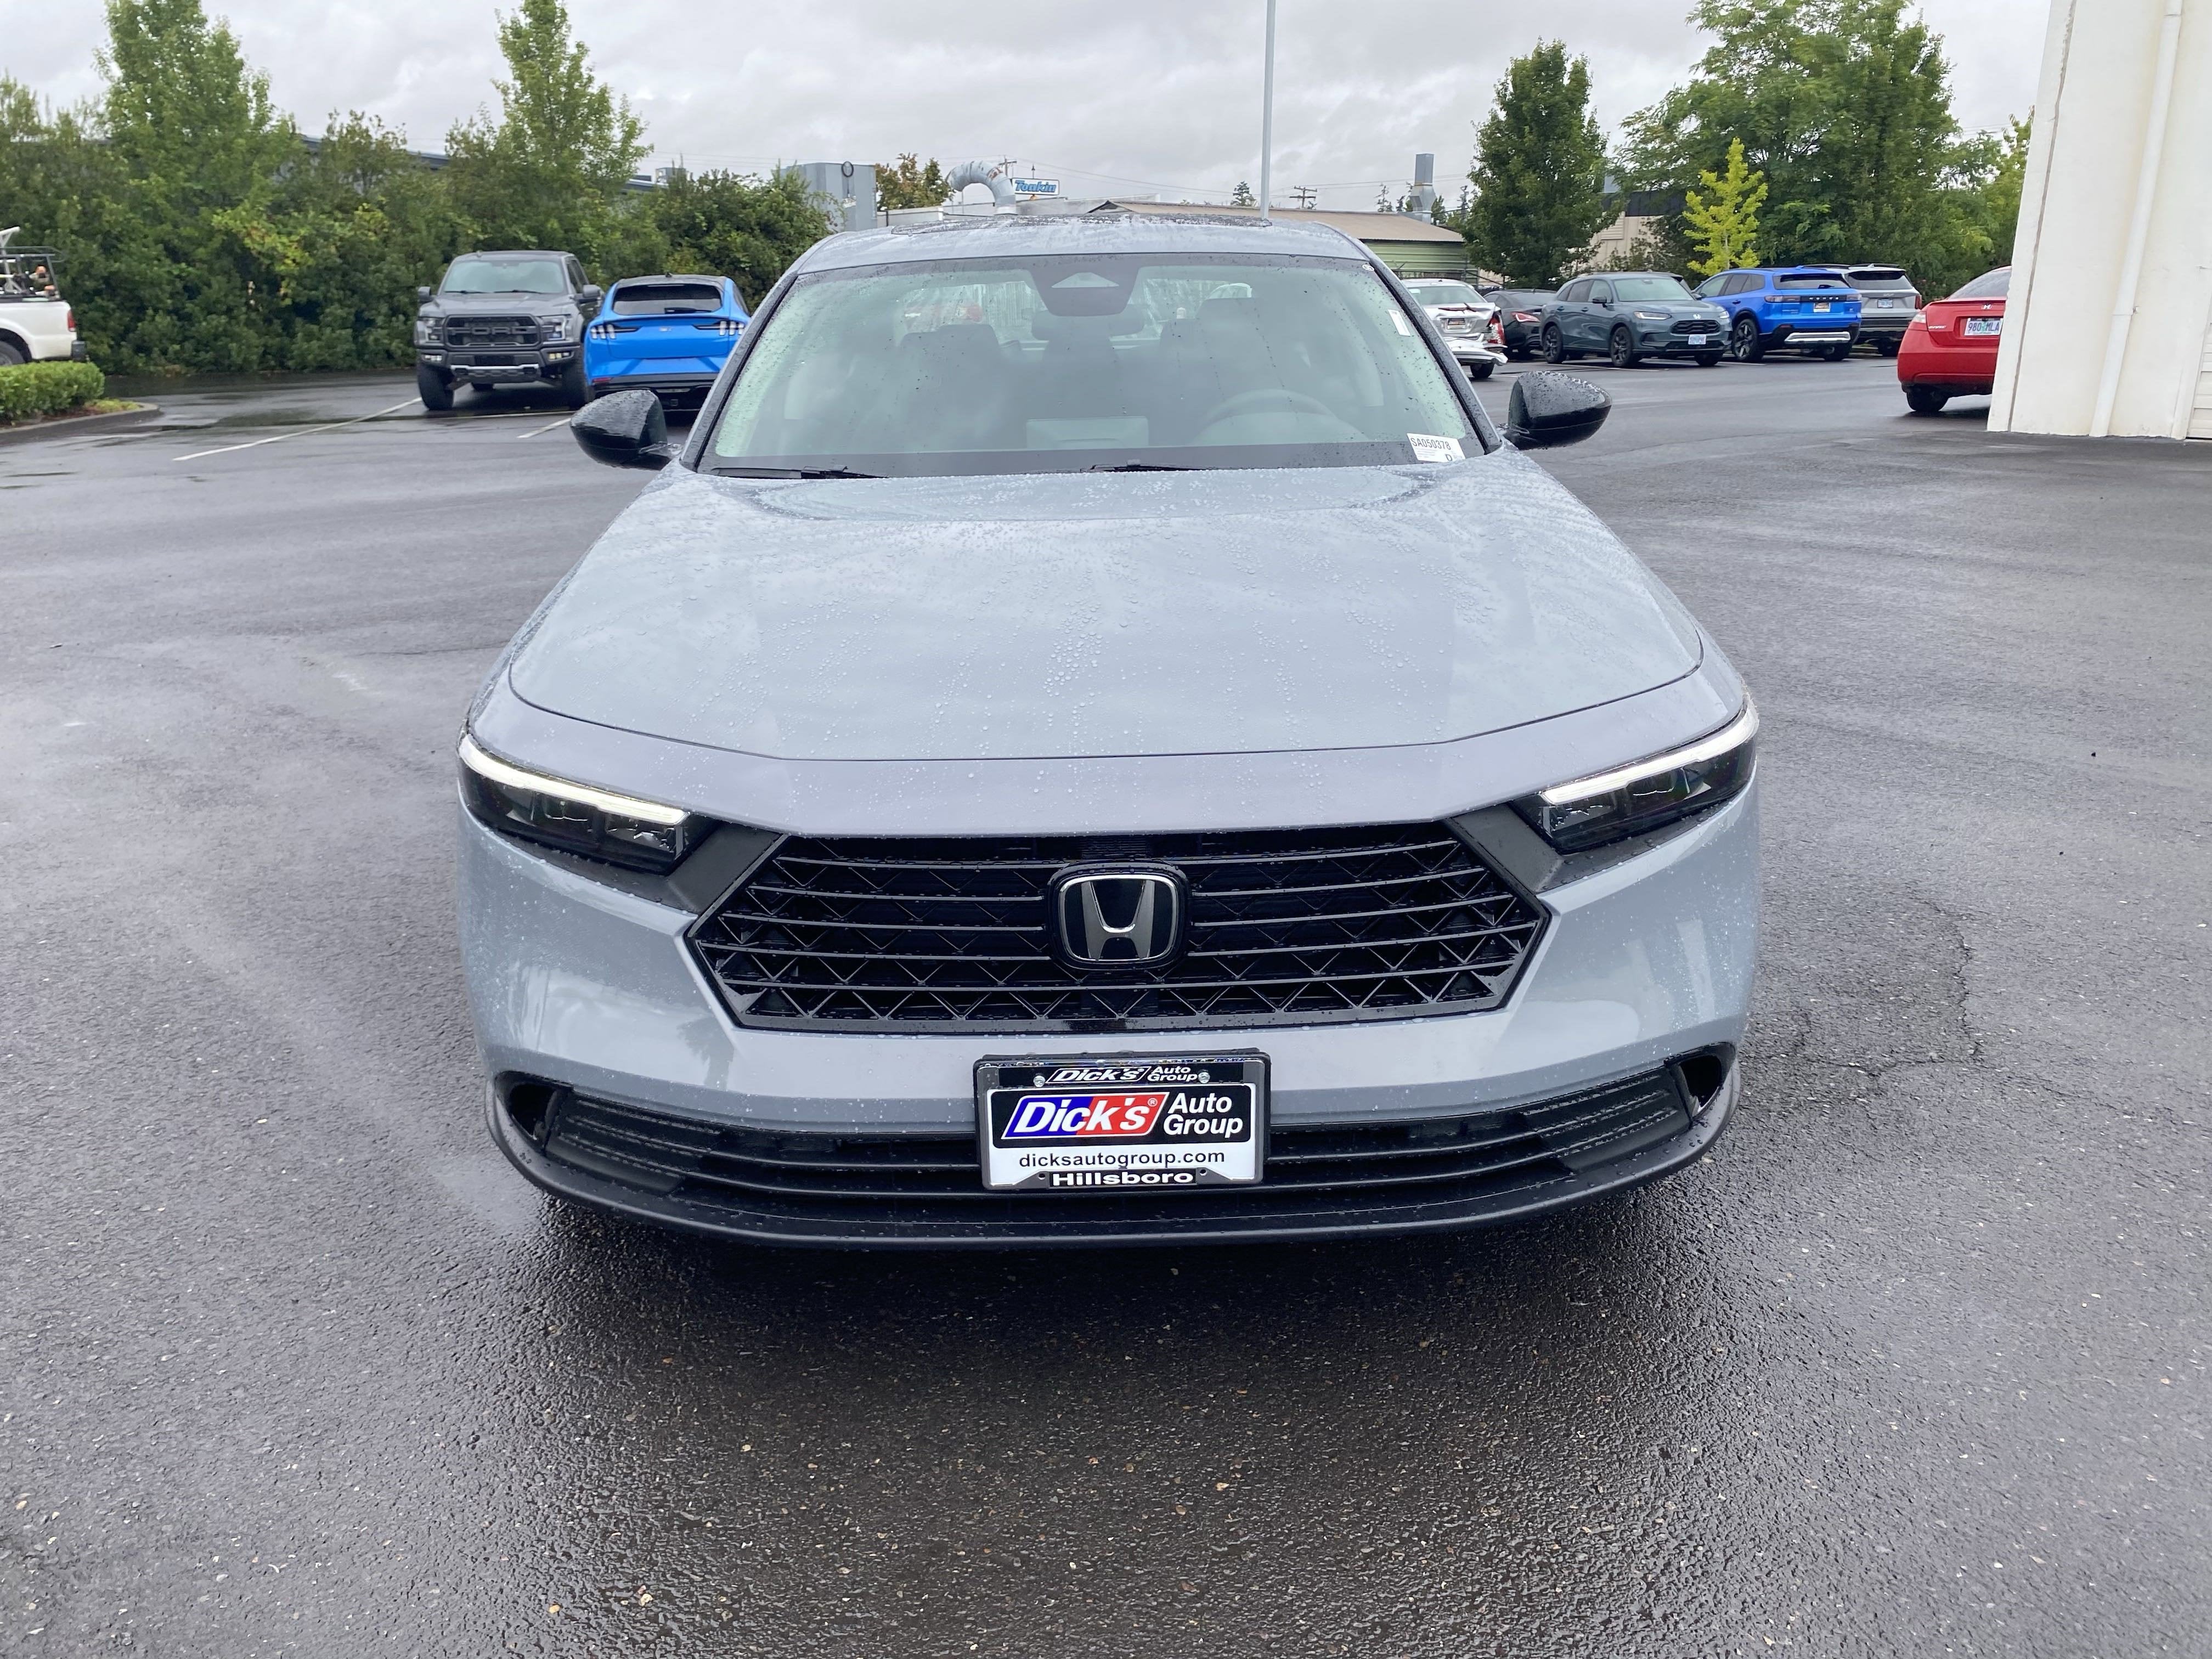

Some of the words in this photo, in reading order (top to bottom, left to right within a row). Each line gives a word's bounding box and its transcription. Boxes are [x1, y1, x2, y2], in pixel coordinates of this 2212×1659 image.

[1015, 180, 1057, 193] Tonkin
[1968, 322, 1982, 331] 980
[1986, 322, 2000, 331] MLA
[1410, 438, 1451, 450] SA050378
[1053, 1067, 1139, 1082] Dick's
[1152, 1066, 1191, 1074] Auto
[1147, 1073, 1198, 1082] Group
[1168, 1093, 1232, 1114] Auto
[1164, 1115, 1243, 1138] Group
[1019, 1152, 1224, 1167] dicksautogroup.com
[1052, 1171, 1193, 1186] Hillsboro
